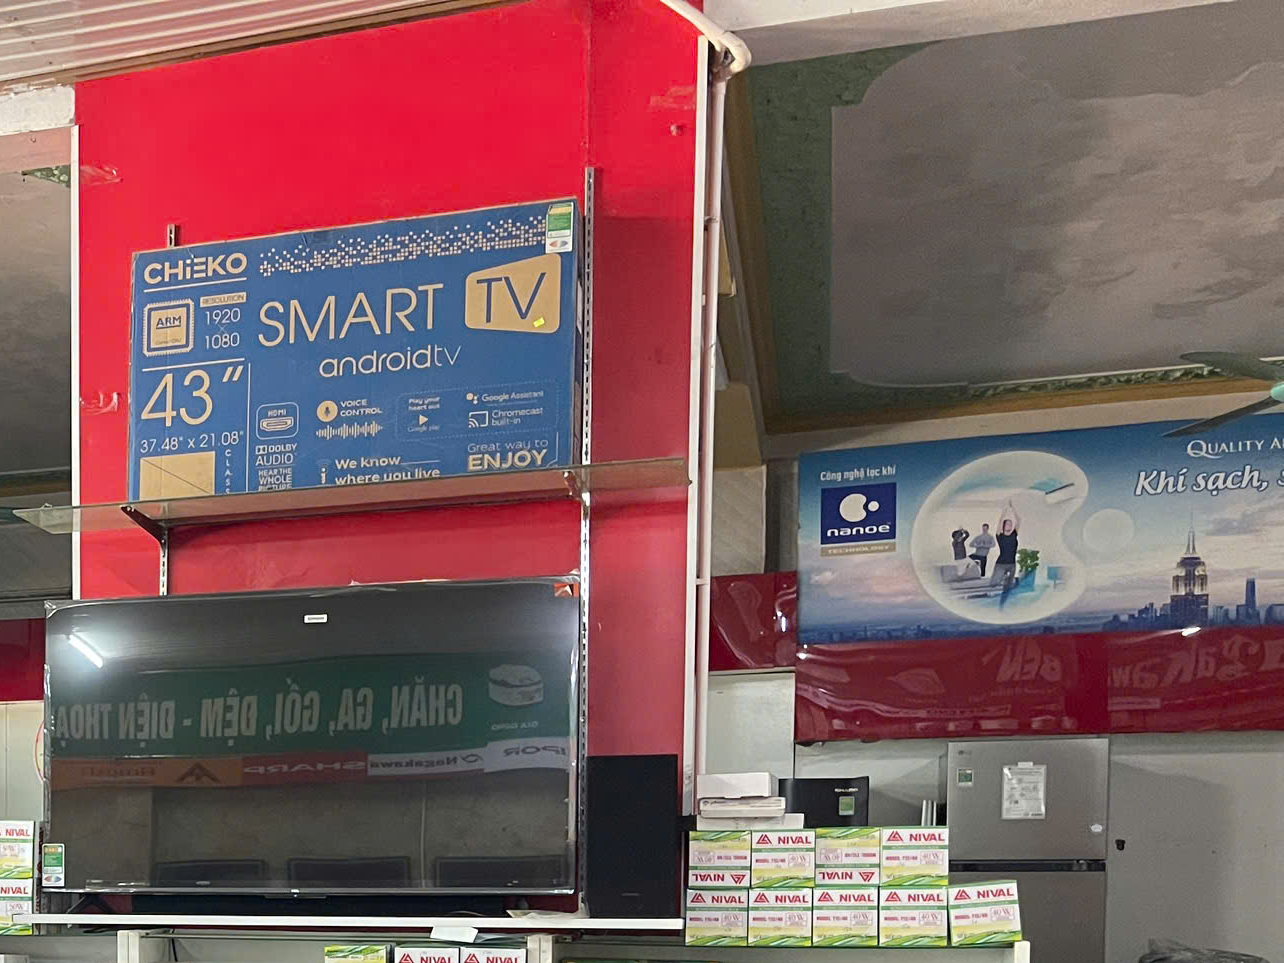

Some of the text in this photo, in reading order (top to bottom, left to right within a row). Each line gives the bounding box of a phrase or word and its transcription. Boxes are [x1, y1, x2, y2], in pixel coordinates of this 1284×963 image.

[202, 293, 245, 306] RESOLUTION
[477, 271, 547, 324] TV
[205, 307, 241, 326] 1920
[257, 282, 445, 348] SMART
[156, 315, 182, 328] ARM
[204, 332, 240, 350] 1080
[481, 392, 510, 402] Google
[340, 399, 367, 408] VOICE
[267, 408, 287, 418] HDMI
[340, 407, 383, 417] CONTROL
[491, 407, 544, 419] Chromecast
[491, 416, 521, 427] built-in
[268, 442, 298, 453] DOLBY
[467, 438, 549, 454] Great way to
[1187, 439, 1264, 459] QUALITY
[255, 454, 294, 466] AUDIO
[334, 456, 401, 470] We know
[468, 448, 548, 472] ENJOY
[277, 467, 292, 475] THE
[334, 471, 381, 486] where
[414, 465, 441, 480] live
[820, 470, 842, 482] Công
[258, 474, 292, 484] WHOLE
[1134, 467, 1187, 497] Khí
[1192, 463, 1268, 496] sạch,
[826, 524, 890, 537] nanoe
[5, 828, 31, 837] NIVAL
[909, 832, 946, 842] NIVAL
[777, 835, 812, 845] NIVAL
[0, 886, 29, 895] NIVAL
[976, 888, 1015, 900] NIVAL
[711, 895, 745, 904] NIVAL
[774, 894, 809, 904] NIVAL
[838, 894, 875, 903] NIVAL
[907, 893, 944, 903] NIVAL
